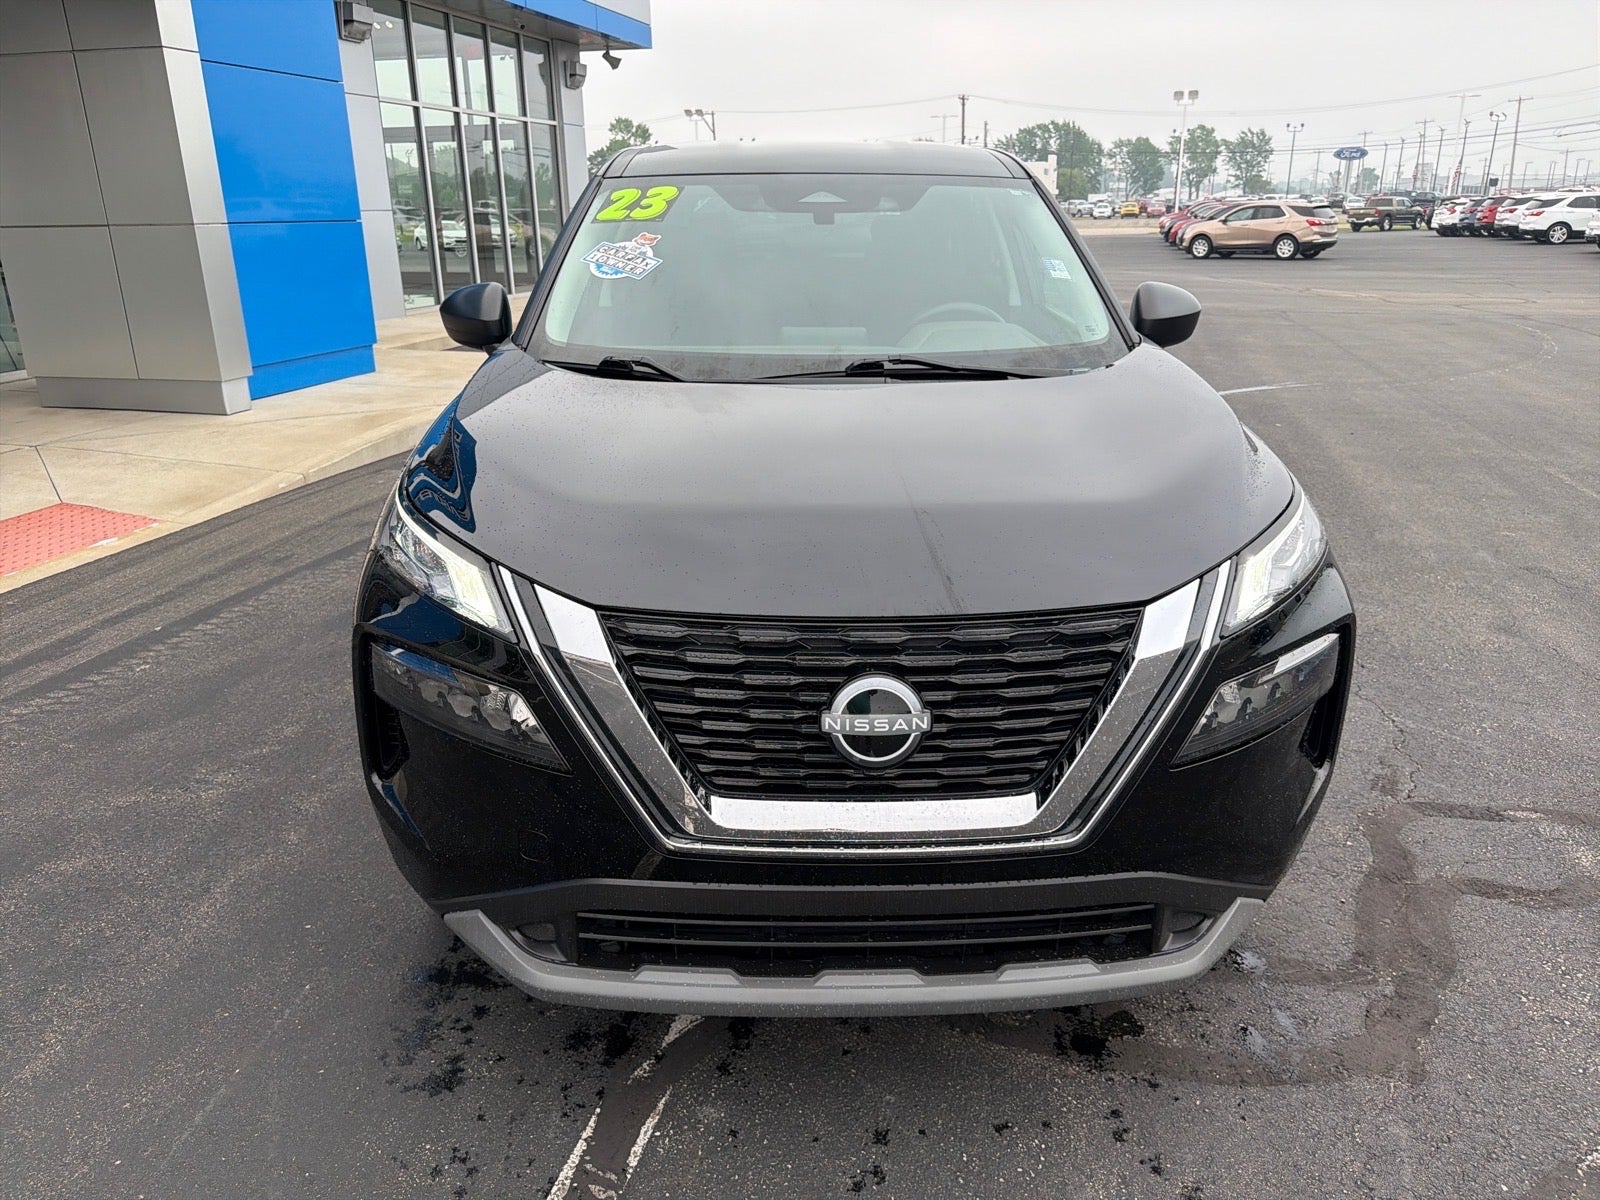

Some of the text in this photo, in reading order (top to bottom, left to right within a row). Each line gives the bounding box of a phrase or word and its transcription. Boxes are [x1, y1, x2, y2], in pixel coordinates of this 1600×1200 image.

[596, 186, 679, 220] 23
[598, 246, 653, 269] CARFAX
[825, 716, 928, 732] NISSAN
